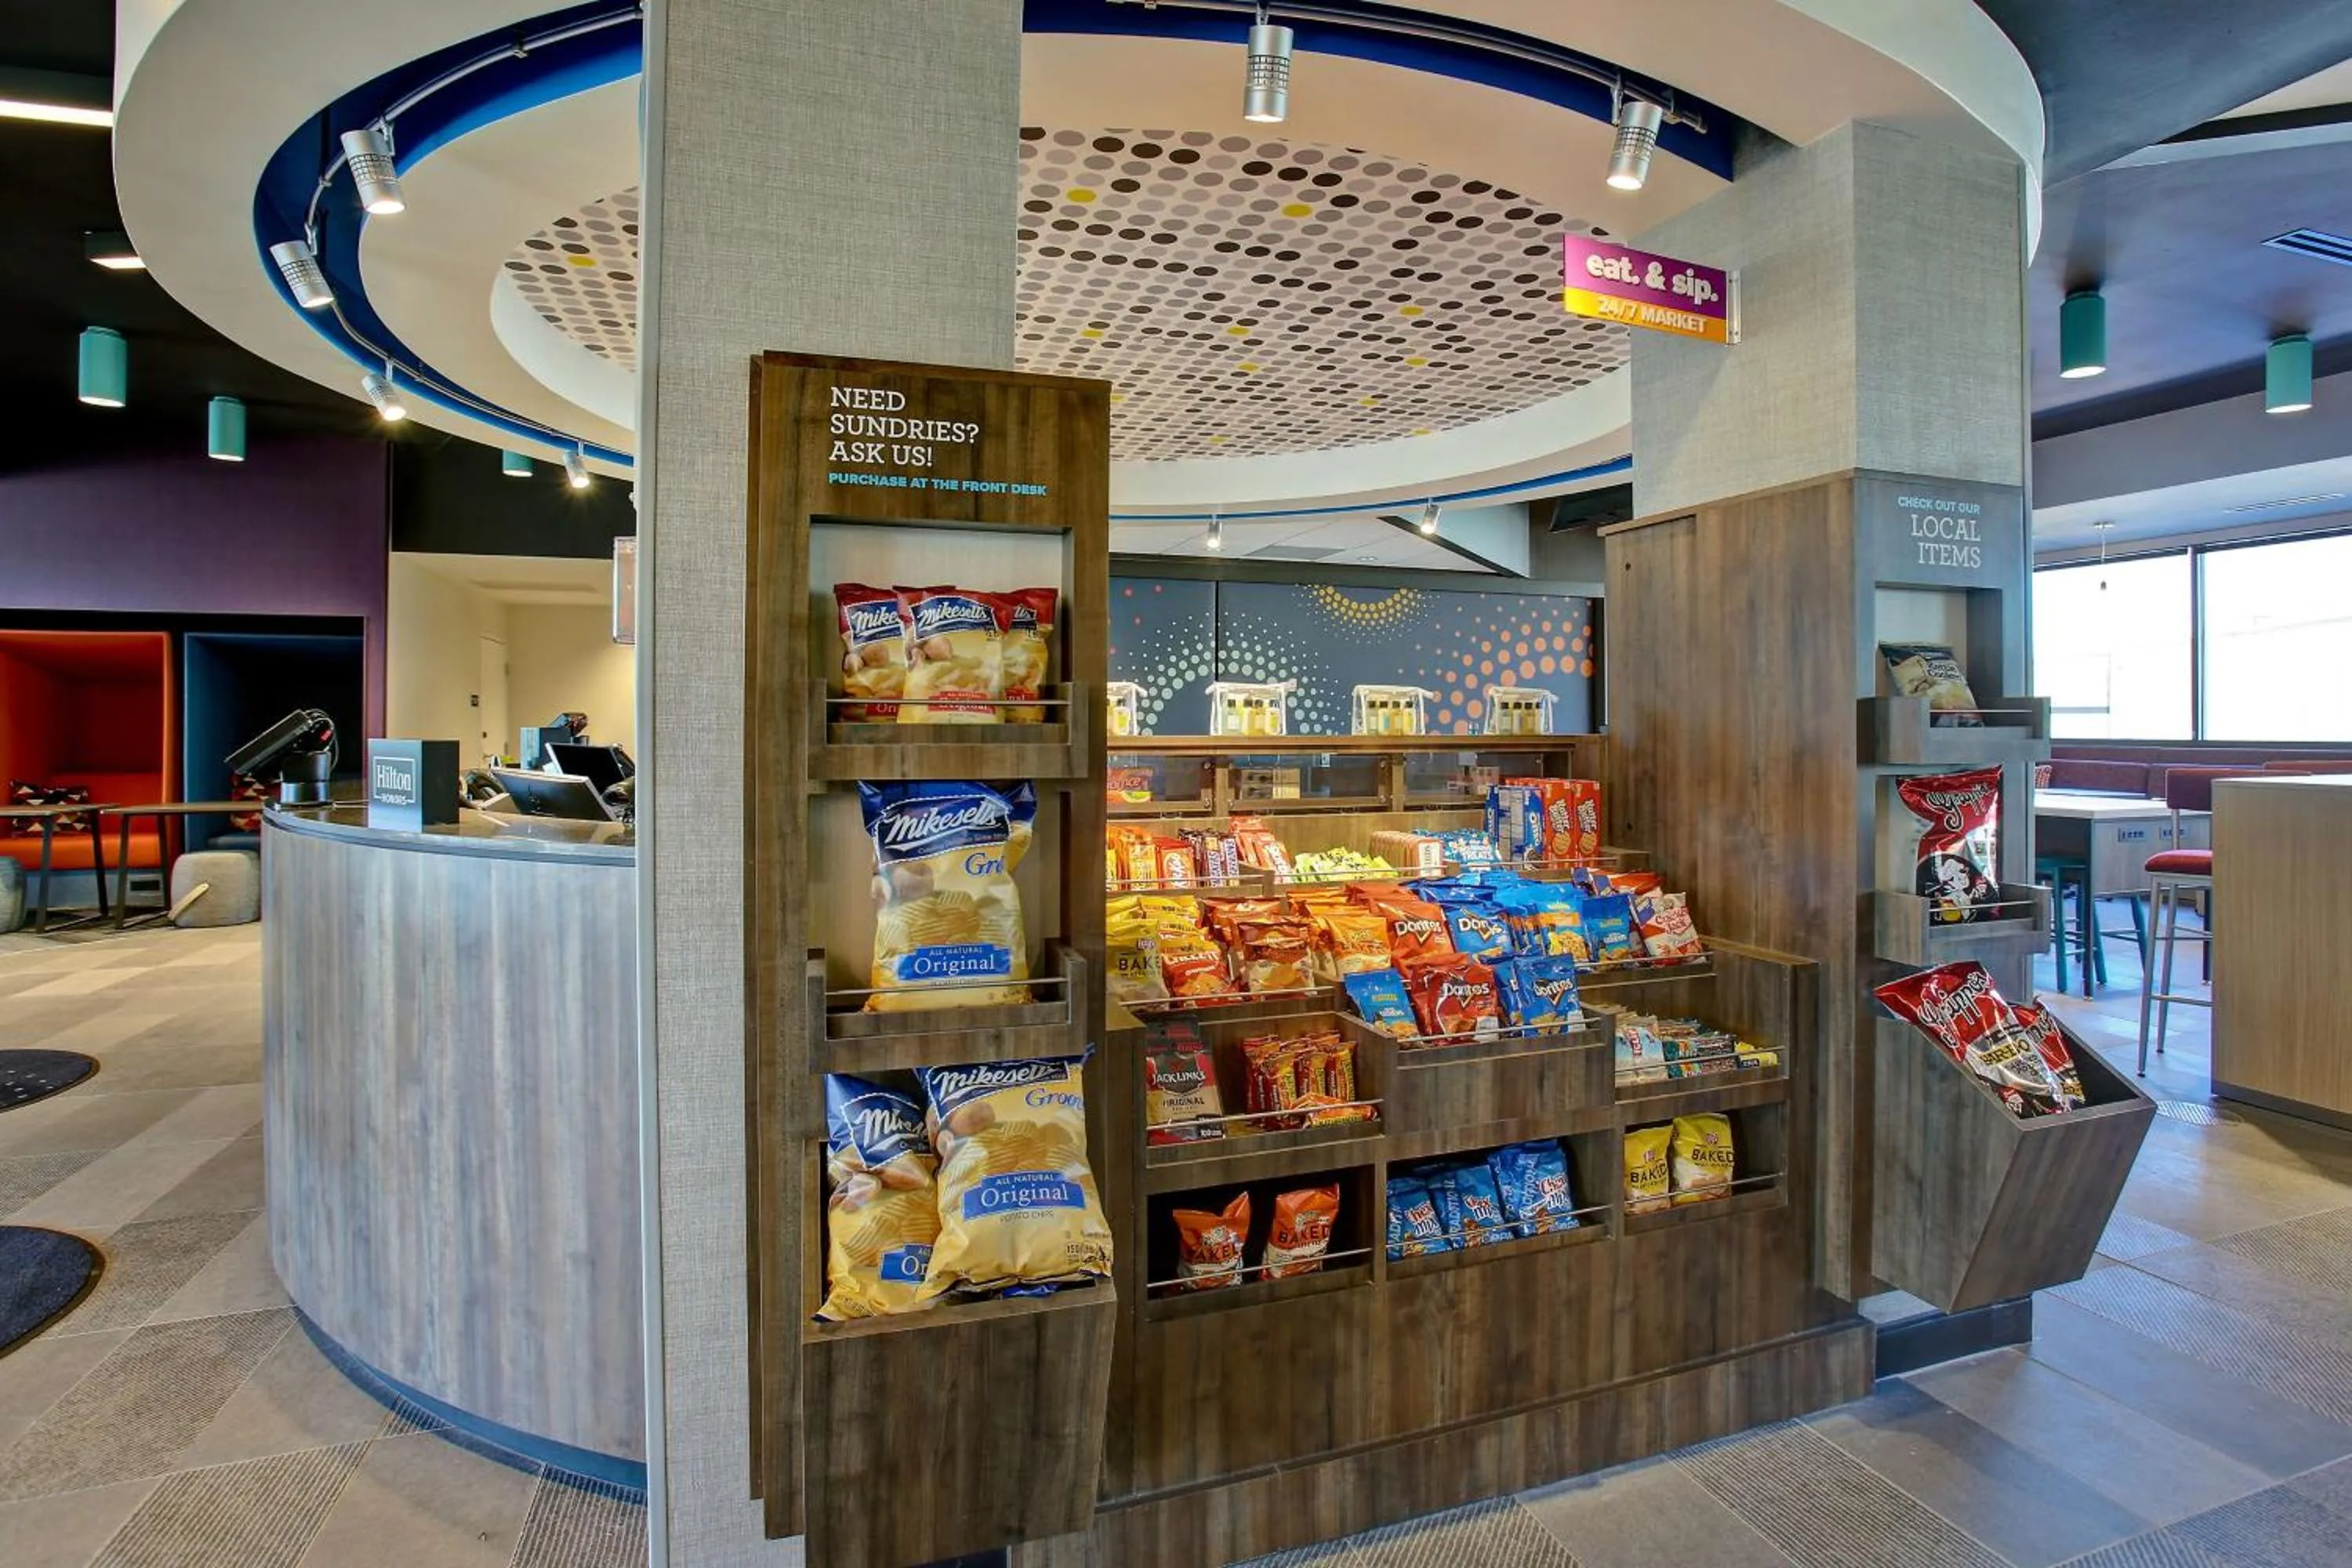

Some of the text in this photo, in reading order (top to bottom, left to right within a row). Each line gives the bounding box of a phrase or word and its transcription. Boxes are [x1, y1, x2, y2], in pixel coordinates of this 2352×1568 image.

[1586, 255, 1719, 305] eat. & sip.
[1598, 297, 1707, 333] 24/7 MARKET
[830, 387, 906, 412] NEED
[830, 413, 979, 444] SUNDRIES?
[829, 441, 933, 466] ASK US!
[829, 473, 1047, 495] PURCHASE AT THE FRONT DESK
[1898, 496, 1980, 514] CHECK OUT OUR
[1911, 514, 1981, 541] LOCAL
[1918, 542, 1981, 568] ITEMS
[376, 764, 412, 791] Hilton
[1395, 920, 1441, 936] Doritos
[915, 953, 995, 976] Original
[1443, 982, 1490, 996] Doritos
[1152, 1073, 1176, 1085] JACK
[1692, 1149, 1733, 1163] BAKED
[996, 1174, 1054, 1185] ALL NATURAL
[981, 1183, 1069, 1207] Original
